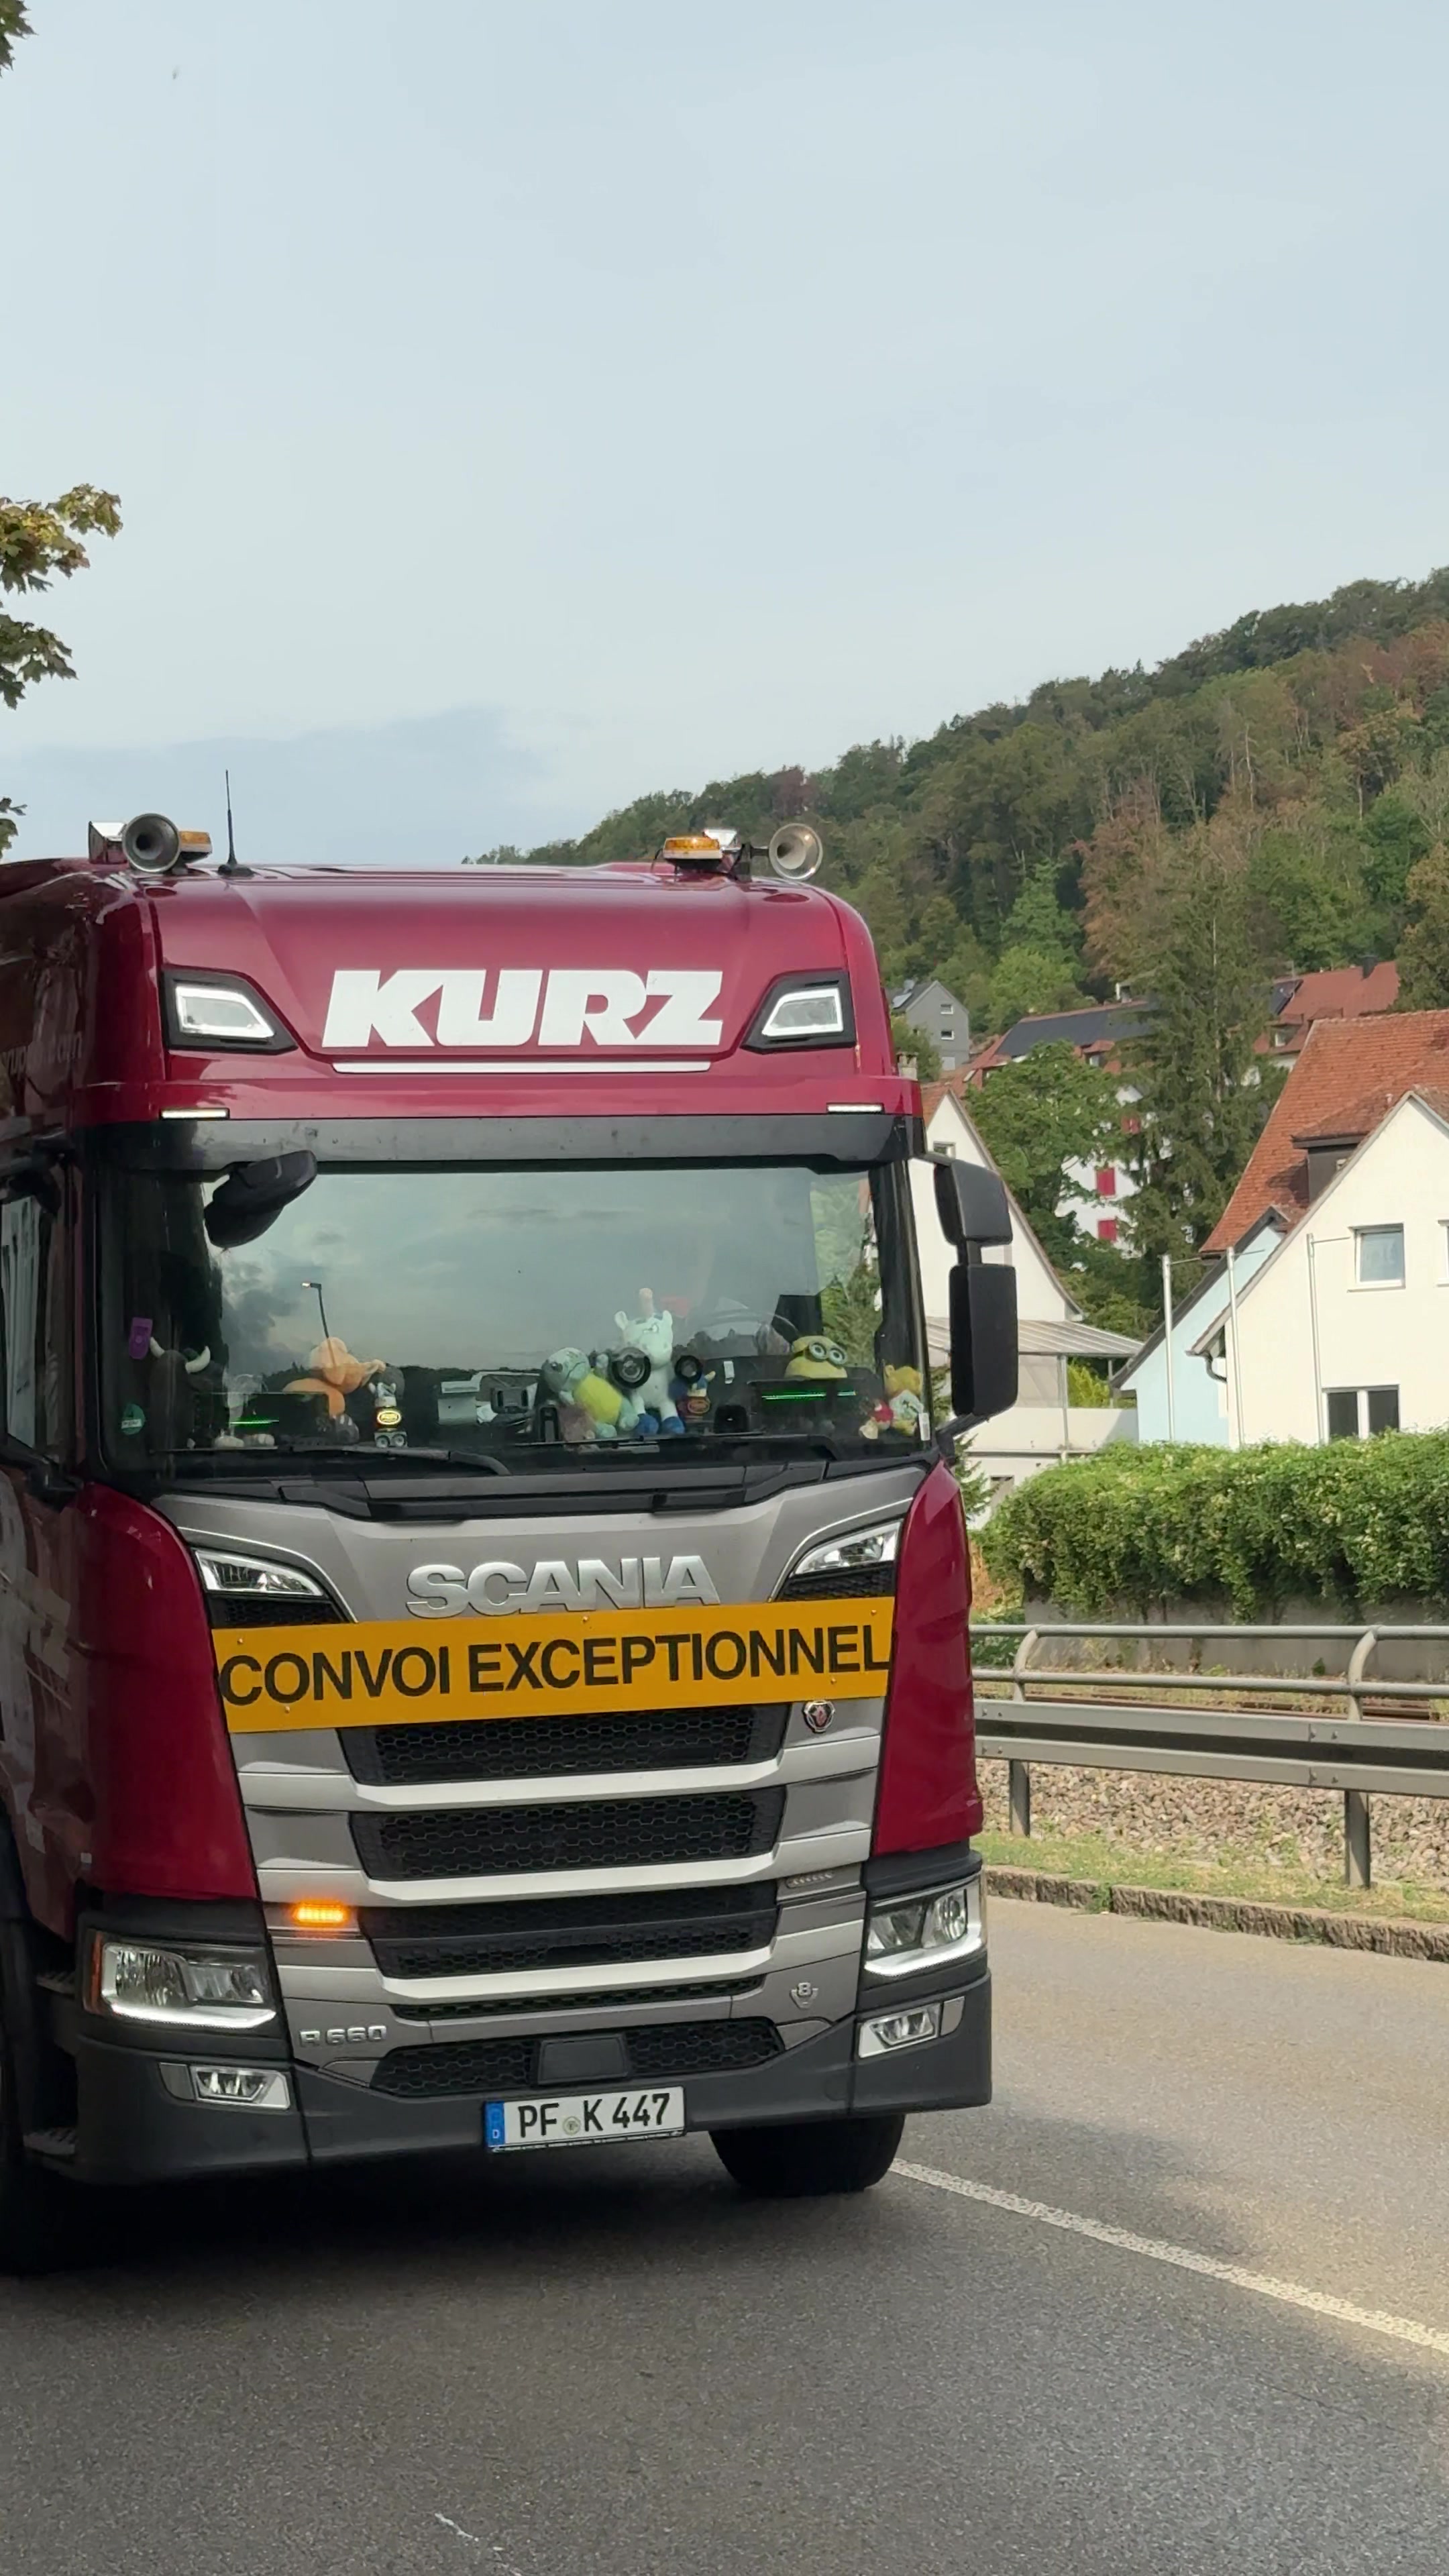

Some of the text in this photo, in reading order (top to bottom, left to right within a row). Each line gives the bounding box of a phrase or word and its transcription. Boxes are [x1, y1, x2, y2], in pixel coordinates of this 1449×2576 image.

[321, 969, 723, 1047] KURZ
[405, 1554, 720, 1619] SCANIA
[220, 1624, 892, 1706] CONVOI EXCEPTIONNEL
[300, 2025, 387, 2047] R 660
[492, 2092, 670, 2139] D PF K 447
